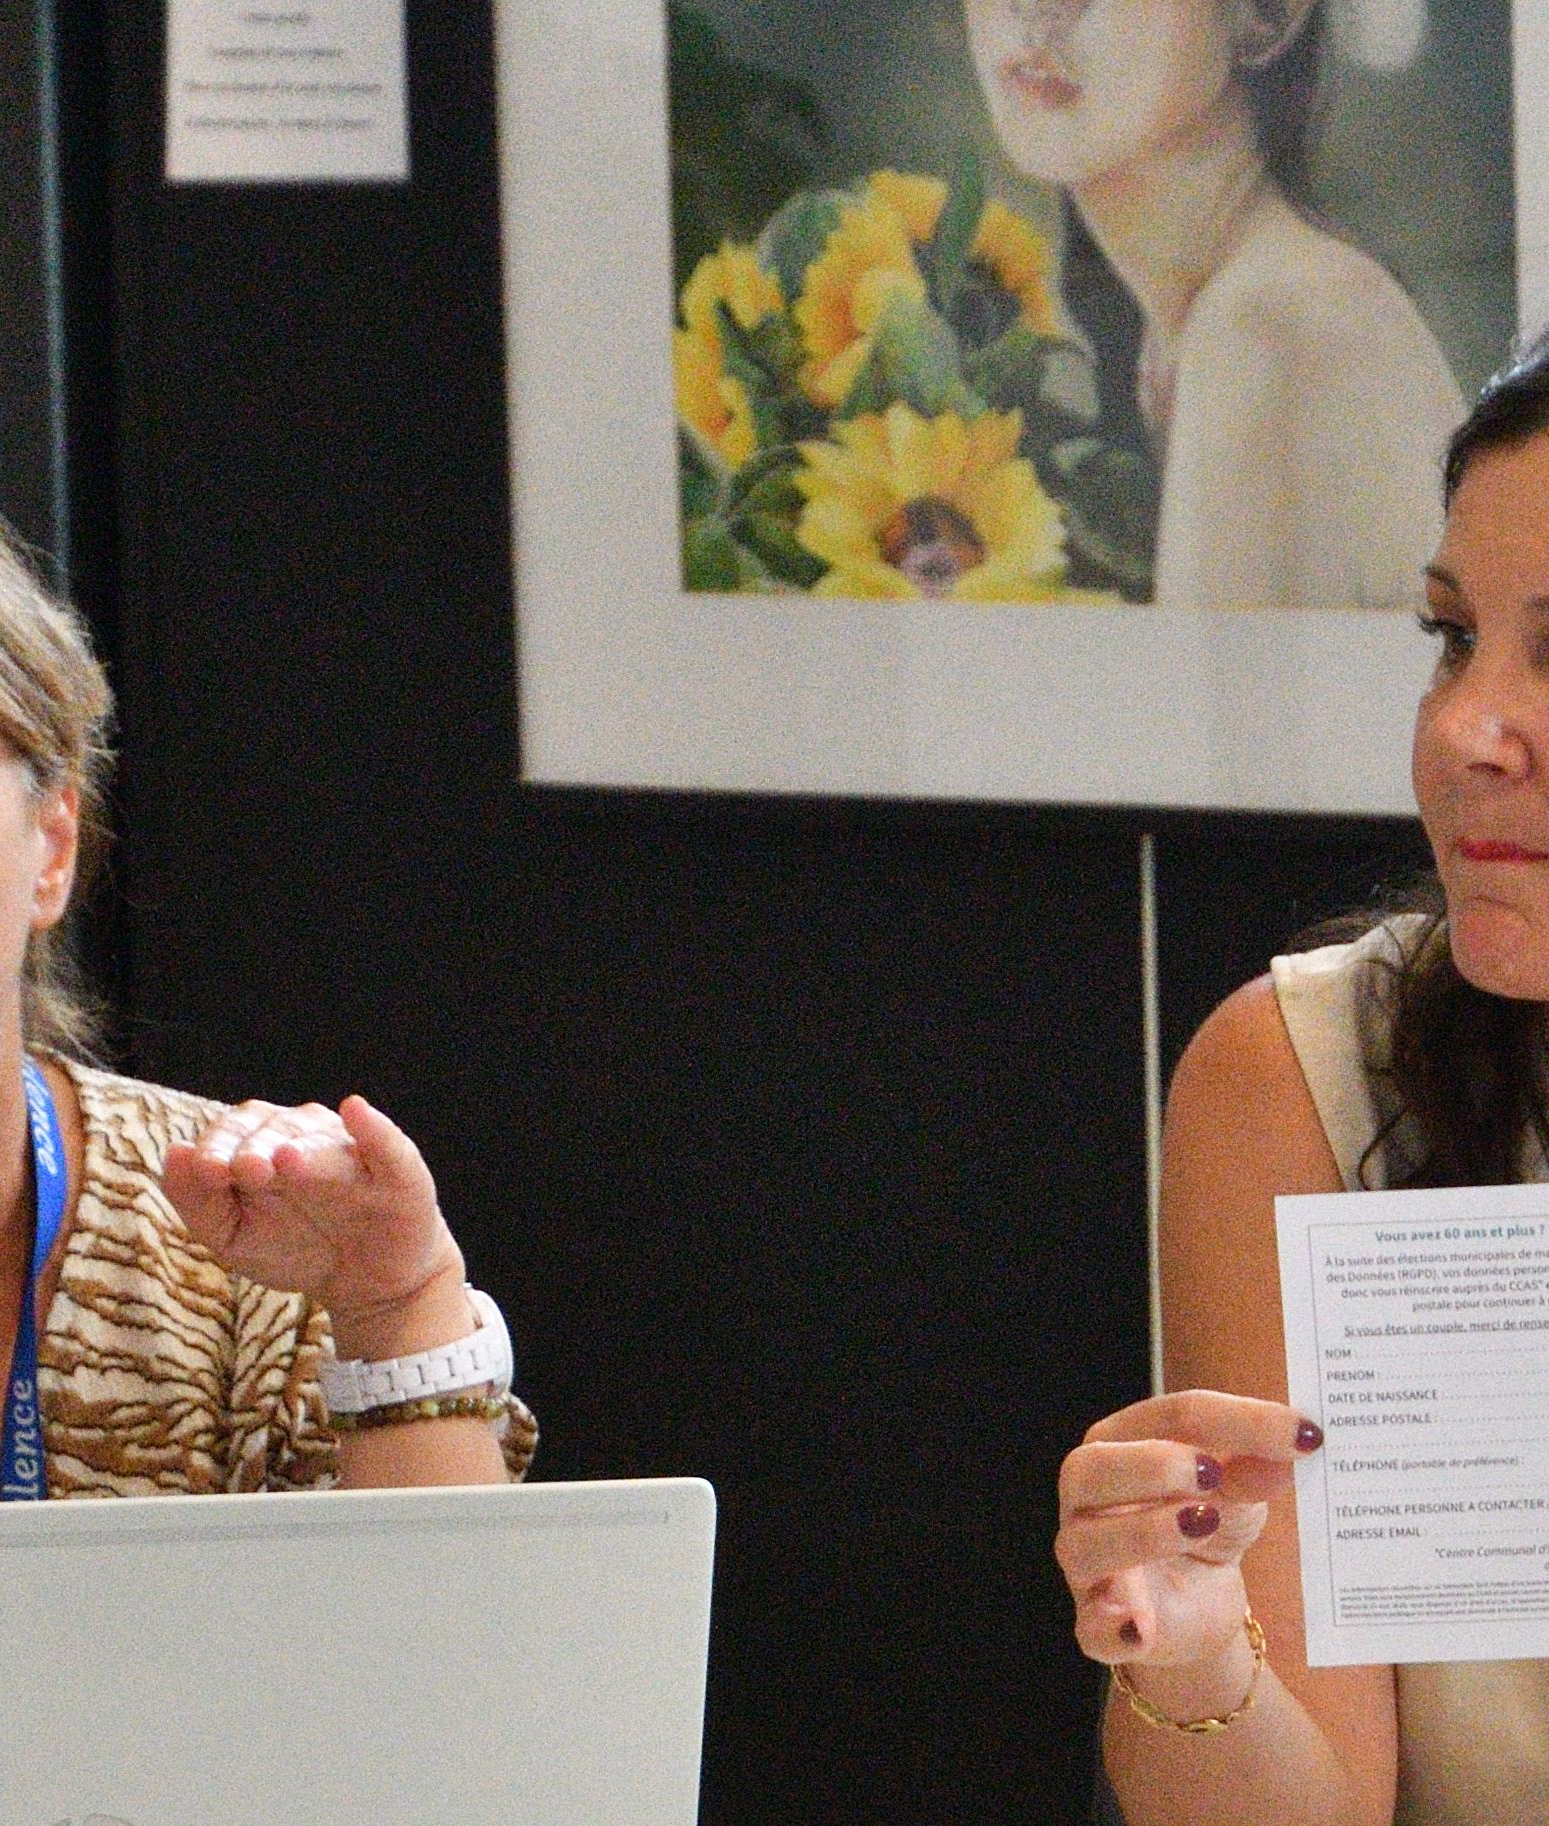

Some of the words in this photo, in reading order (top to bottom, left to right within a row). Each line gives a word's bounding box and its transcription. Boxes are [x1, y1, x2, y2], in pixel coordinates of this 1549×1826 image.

[1375, 1232, 1407, 1242] Vous
[1411, 1231, 1441, 1241] avez
[1464, 1229, 1487, 1239] ans
[1507, 1225, 1535, 1239] plus
[1347, 1257, 1374, 1266] suite
[1377, 1256, 1395, 1265] des
[1397, 1254, 1447, 1264] élections
[1450, 1251, 1516, 1262] municipales
[1326, 1273, 1346, 1283] des
[1348, 1272, 1395, 1282] Données
[1442, 1270, 1461, 1278] vos
[1463, 1267, 1511, 1277] données
[1341, 1289, 1368, 1298] donc
[1371, 1289, 1397, 1297] vous
[1452, 1284, 1490, 1295] auprès
[1412, 1300, 1452, 1313] postale
[1455, 1300, 1480, 1311] pour
[1483, 1298, 1535, 1308] continuer
[1325, 1349, 1351, 1358] NOM
[1326, 1370, 1375, 1381] PRENOM
[1328, 1392, 1355, 1404] DATE
[1376, 1389, 1437, 1402] NAISSANCE
[1329, 1415, 1378, 1427] ADRESSE
[1382, 1413, 1431, 1424] POSTALE
[2, 1380, 39, 1501] lence
[1333, 1459, 1398, 1472] TÉLÉPHONE
[1336, 1505, 1401, 1517] TÉLÉPHONE
[1404, 1502, 1464, 1515] PERSONNE
[1477, 1499, 1544, 1512] CONTACTER
[1336, 1528, 1384, 1540] ADRESSE
[1389, 1527, 1421, 1538] EMAIL
